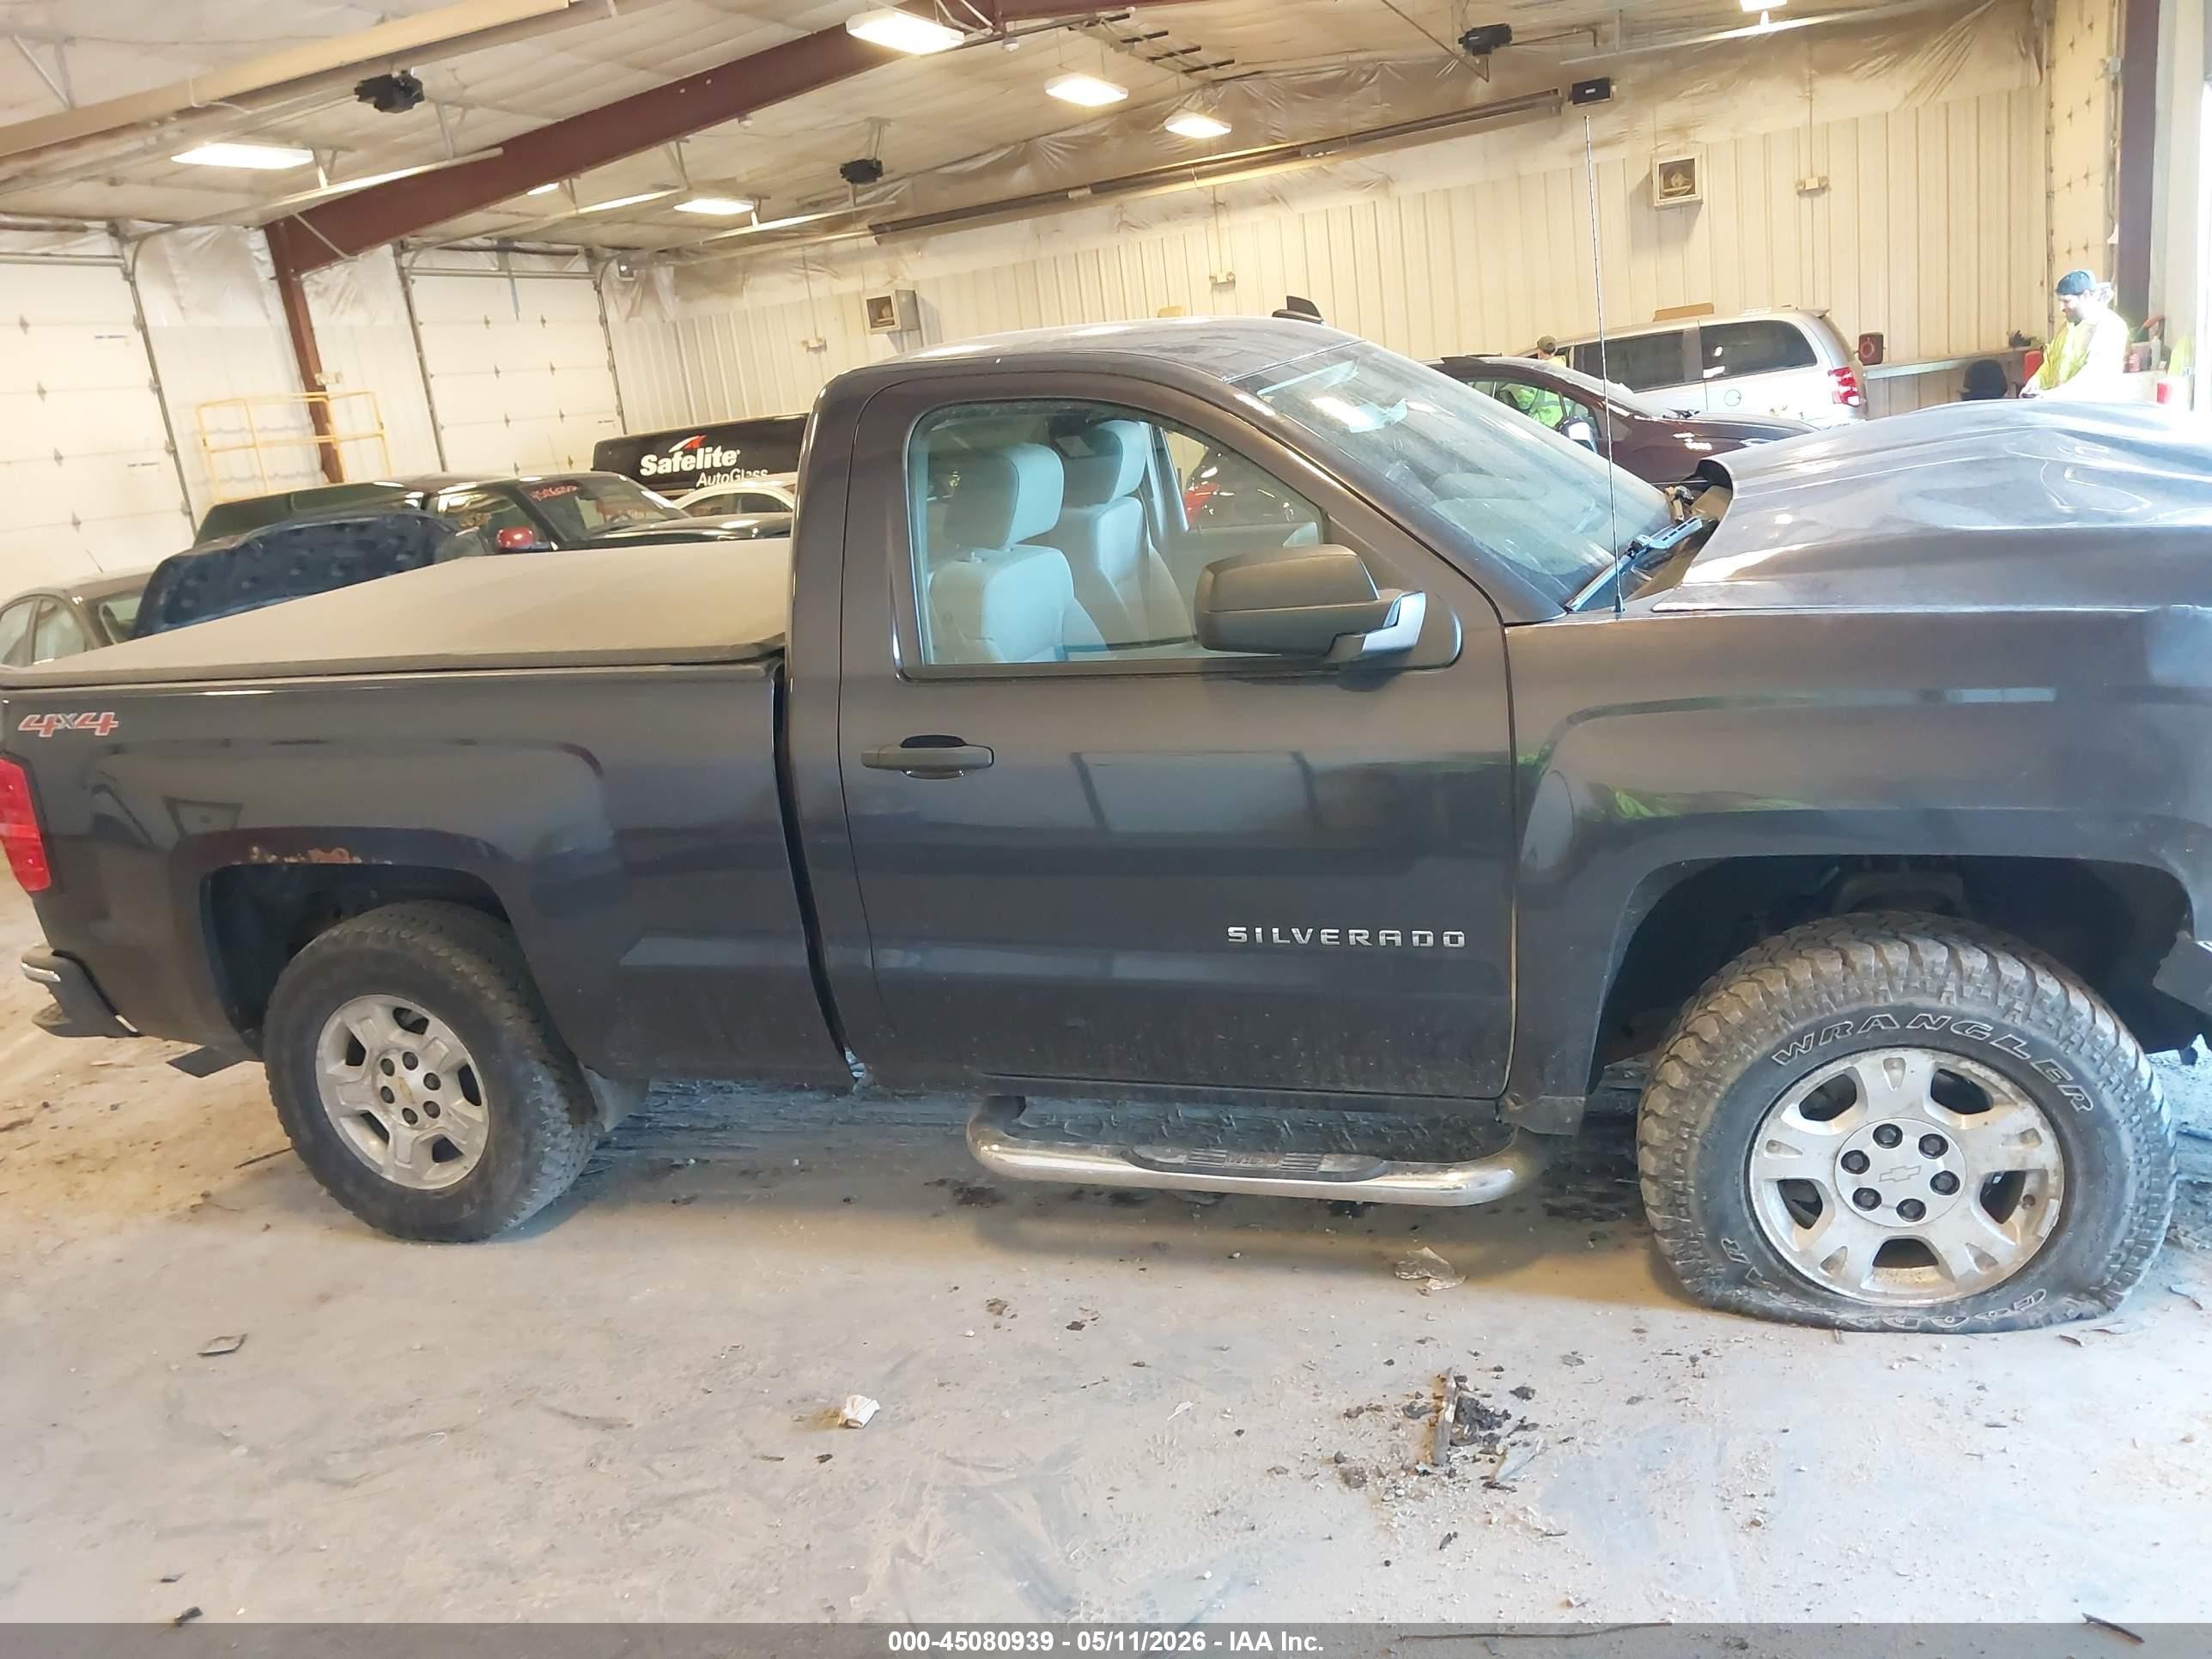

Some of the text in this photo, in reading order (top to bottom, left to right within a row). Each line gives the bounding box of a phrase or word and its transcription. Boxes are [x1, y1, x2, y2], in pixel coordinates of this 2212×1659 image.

[639, 445, 738, 477] Safelite
[696, 467, 769, 488] AutoGlass
[1226, 926, 1466, 949] SILVERADO
[1771, 1013, 2094, 1115] WRANGLER
